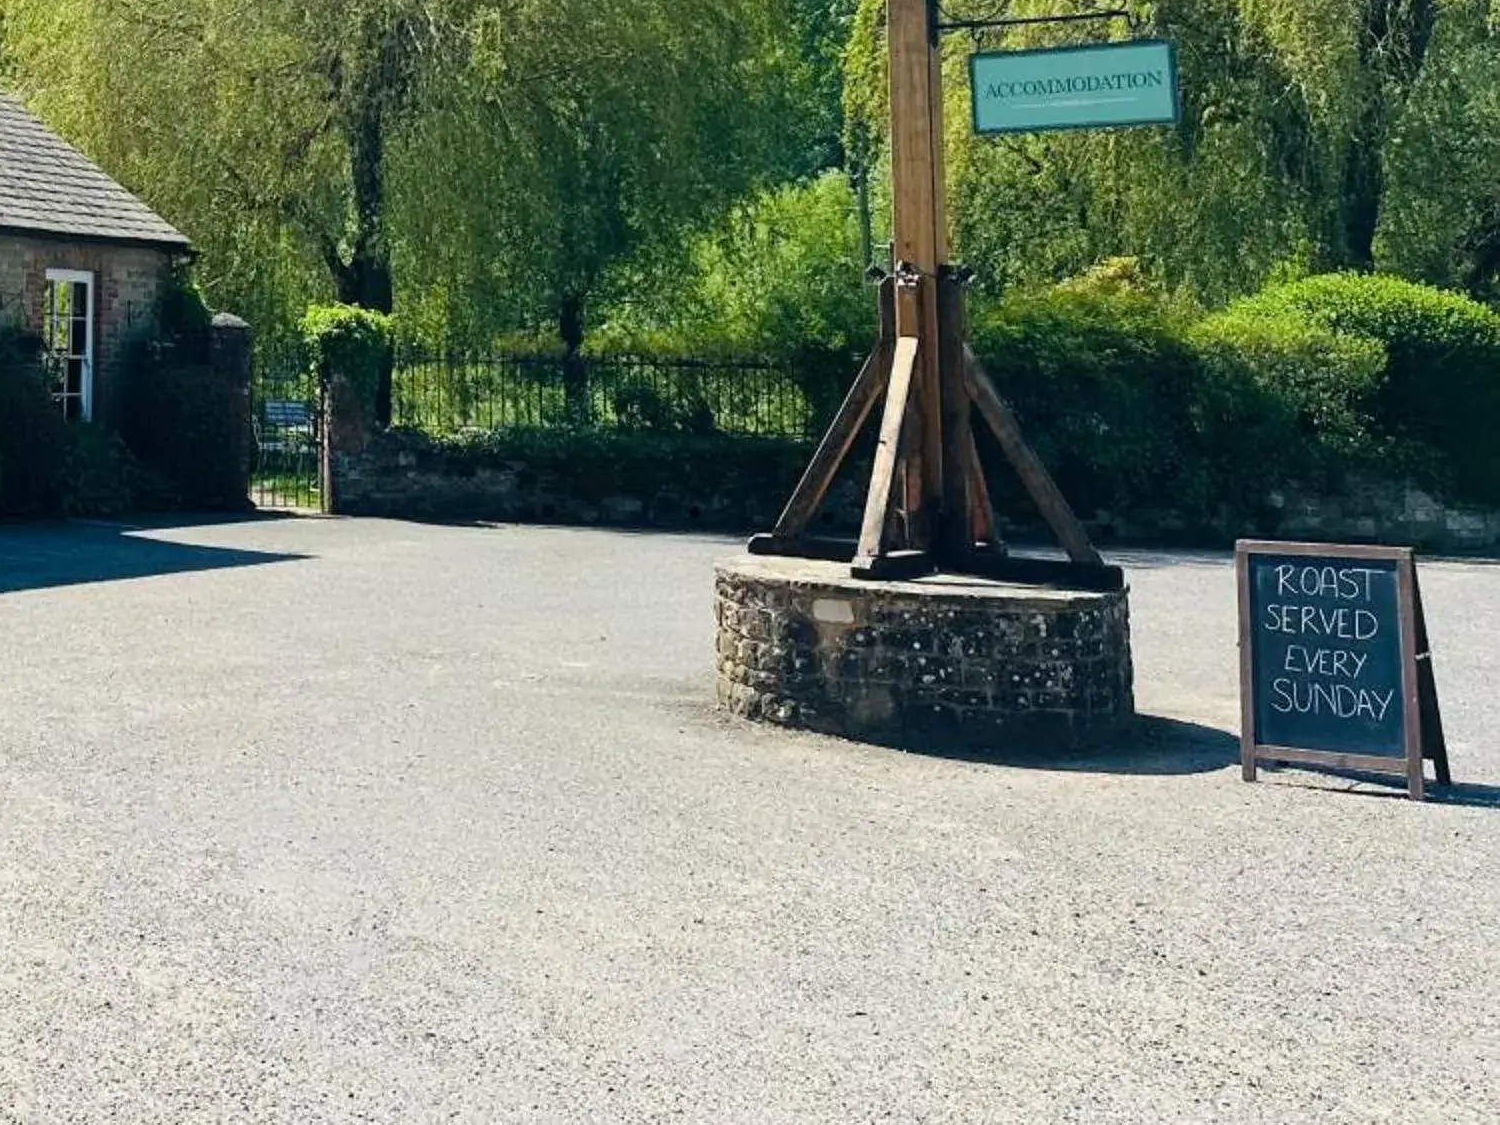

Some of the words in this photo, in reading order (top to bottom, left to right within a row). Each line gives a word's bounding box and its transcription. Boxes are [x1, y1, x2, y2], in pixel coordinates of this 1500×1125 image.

[985, 70, 1162, 99] ACCOMMODATION
[1274, 564, 1386, 602] ROAST
[1264, 603, 1379, 640] SERVED
[1284, 644, 1368, 679] EVERY
[1270, 678, 1395, 721] SUNDAY
